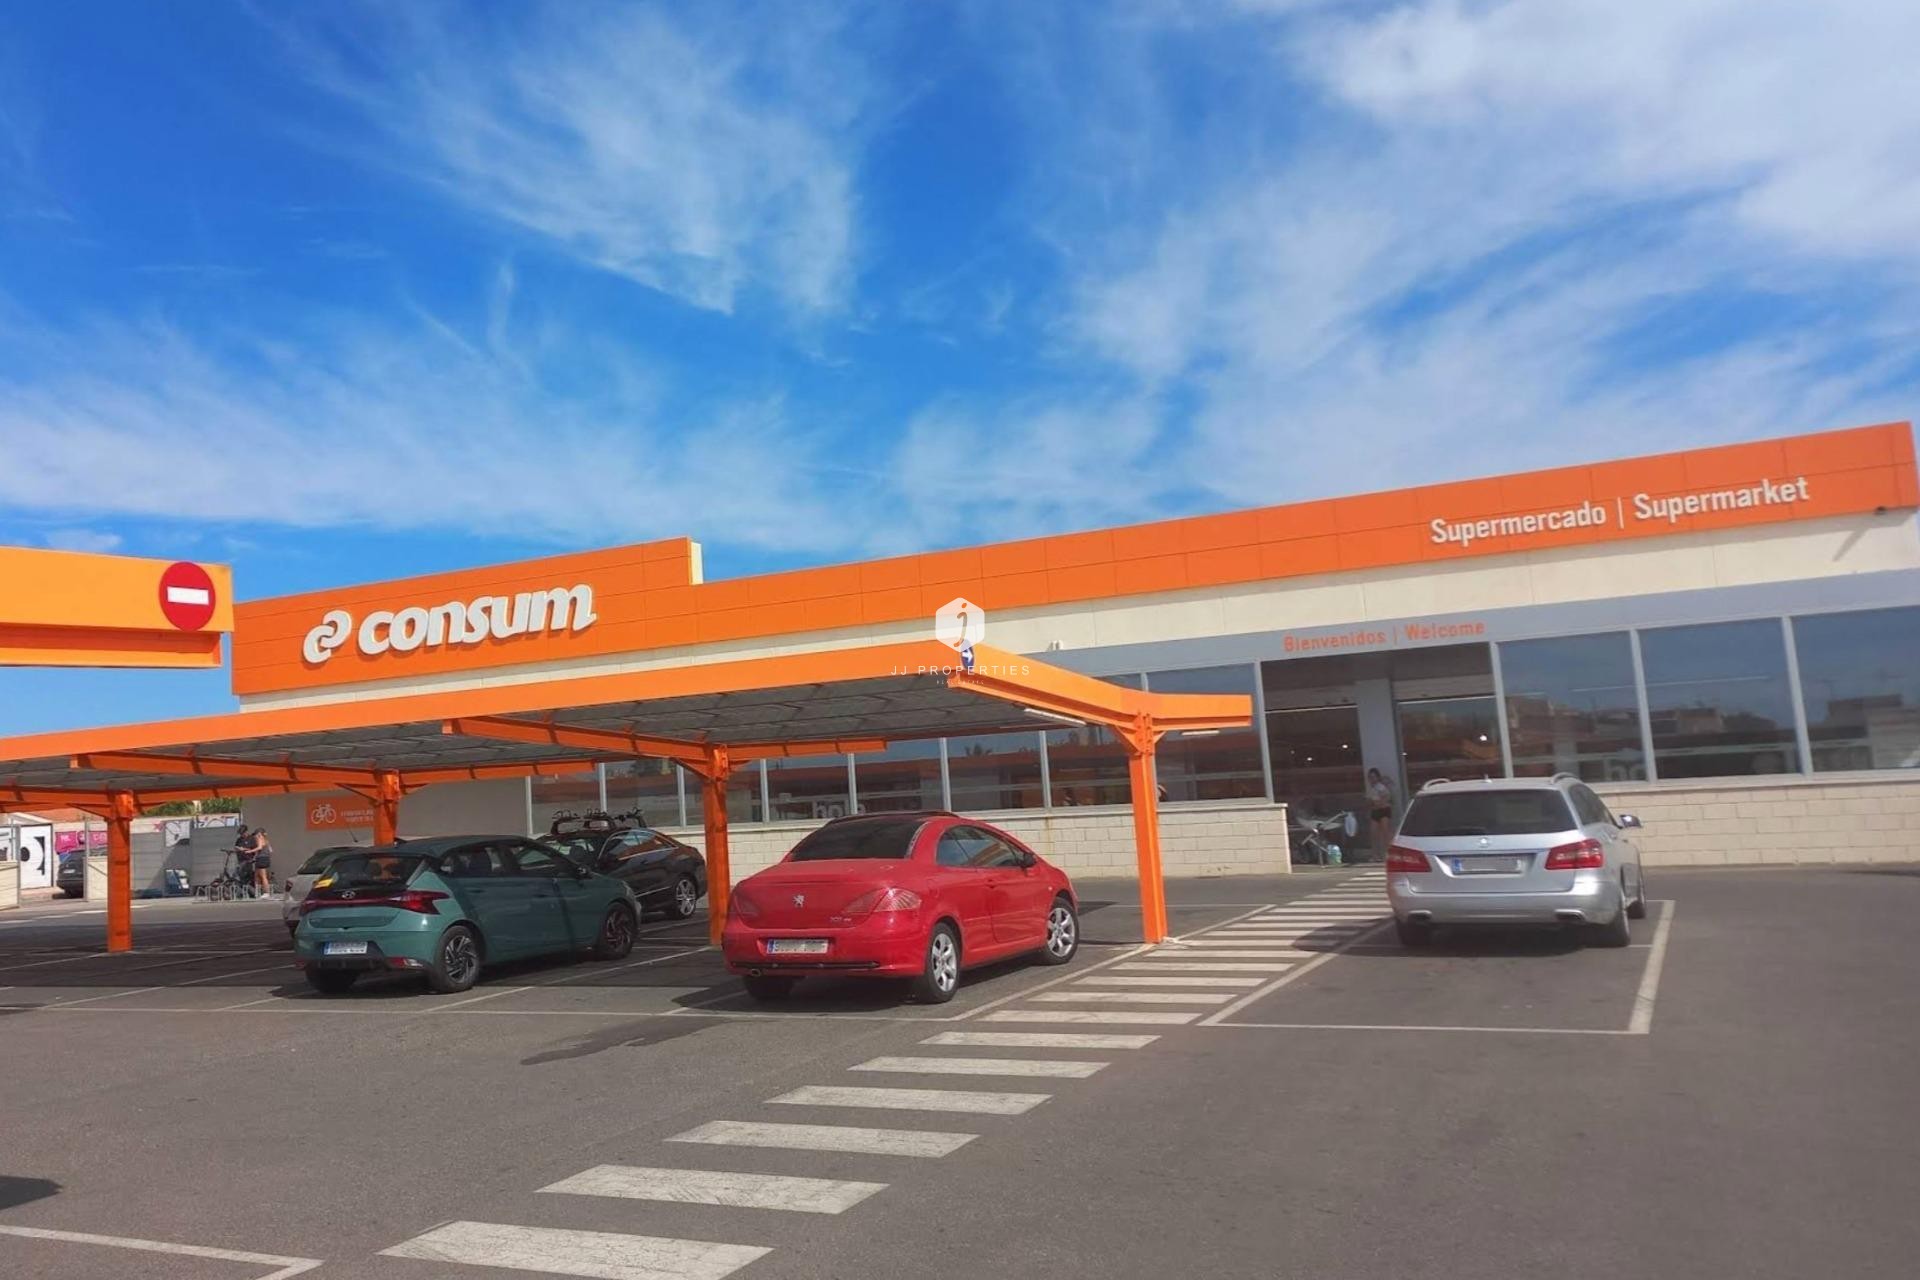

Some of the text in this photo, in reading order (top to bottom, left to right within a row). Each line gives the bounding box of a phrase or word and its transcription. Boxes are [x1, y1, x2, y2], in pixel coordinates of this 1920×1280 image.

[1431, 477, 1809, 547] Supermercado Supermarket
[358, 584, 597, 655] consum
[1283, 621, 1485, 652] Bienvenidos Welcome
